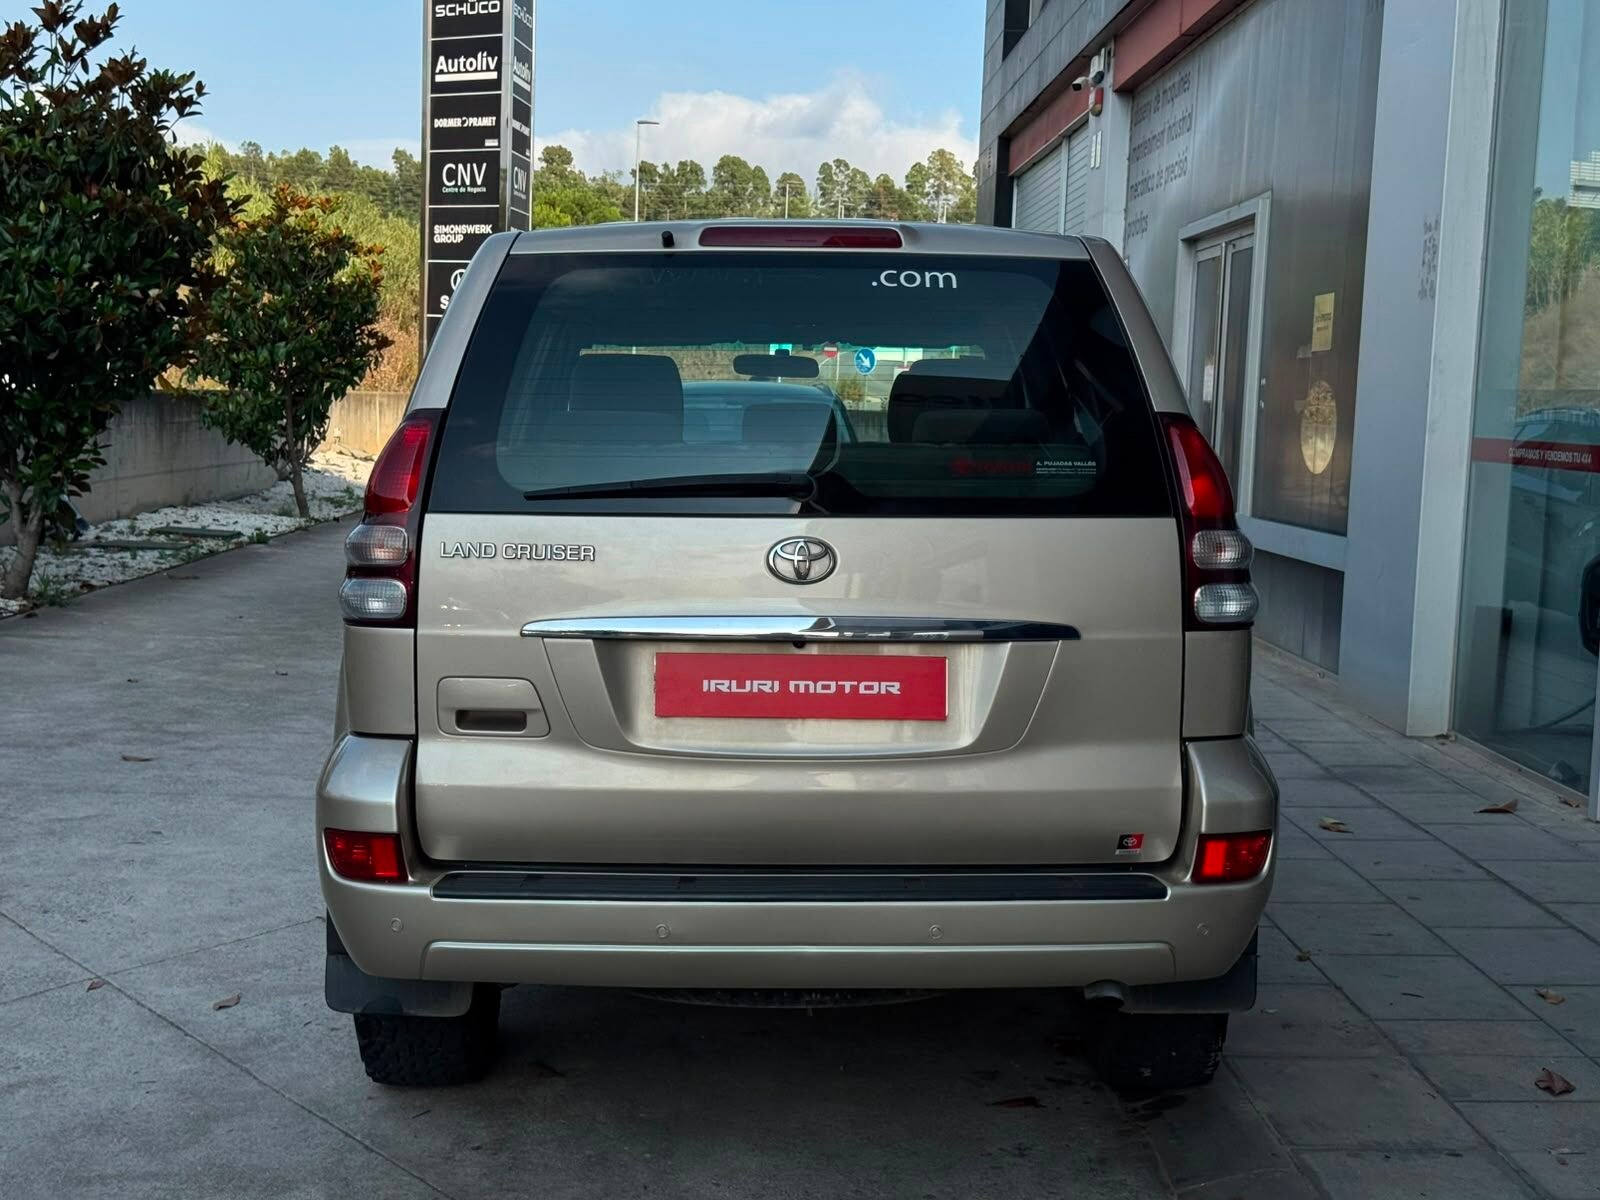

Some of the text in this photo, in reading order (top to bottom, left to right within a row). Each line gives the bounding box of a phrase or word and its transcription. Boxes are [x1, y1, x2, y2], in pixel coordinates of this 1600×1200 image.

[435, 0, 500, 17] SCHÜCO
[435, 51, 498, 73] Autoliv
[434, 116, 497, 128] DORMER PRAMET
[442, 163, 487, 186] CNV
[434, 224, 493, 234] SIMONSWERK
[434, 234, 464, 243] GROUP
[872, 270, 957, 289] .com
[440, 541, 596, 561] LAND CRUISER
[703, 679, 901, 694] IRURI MOTOR
